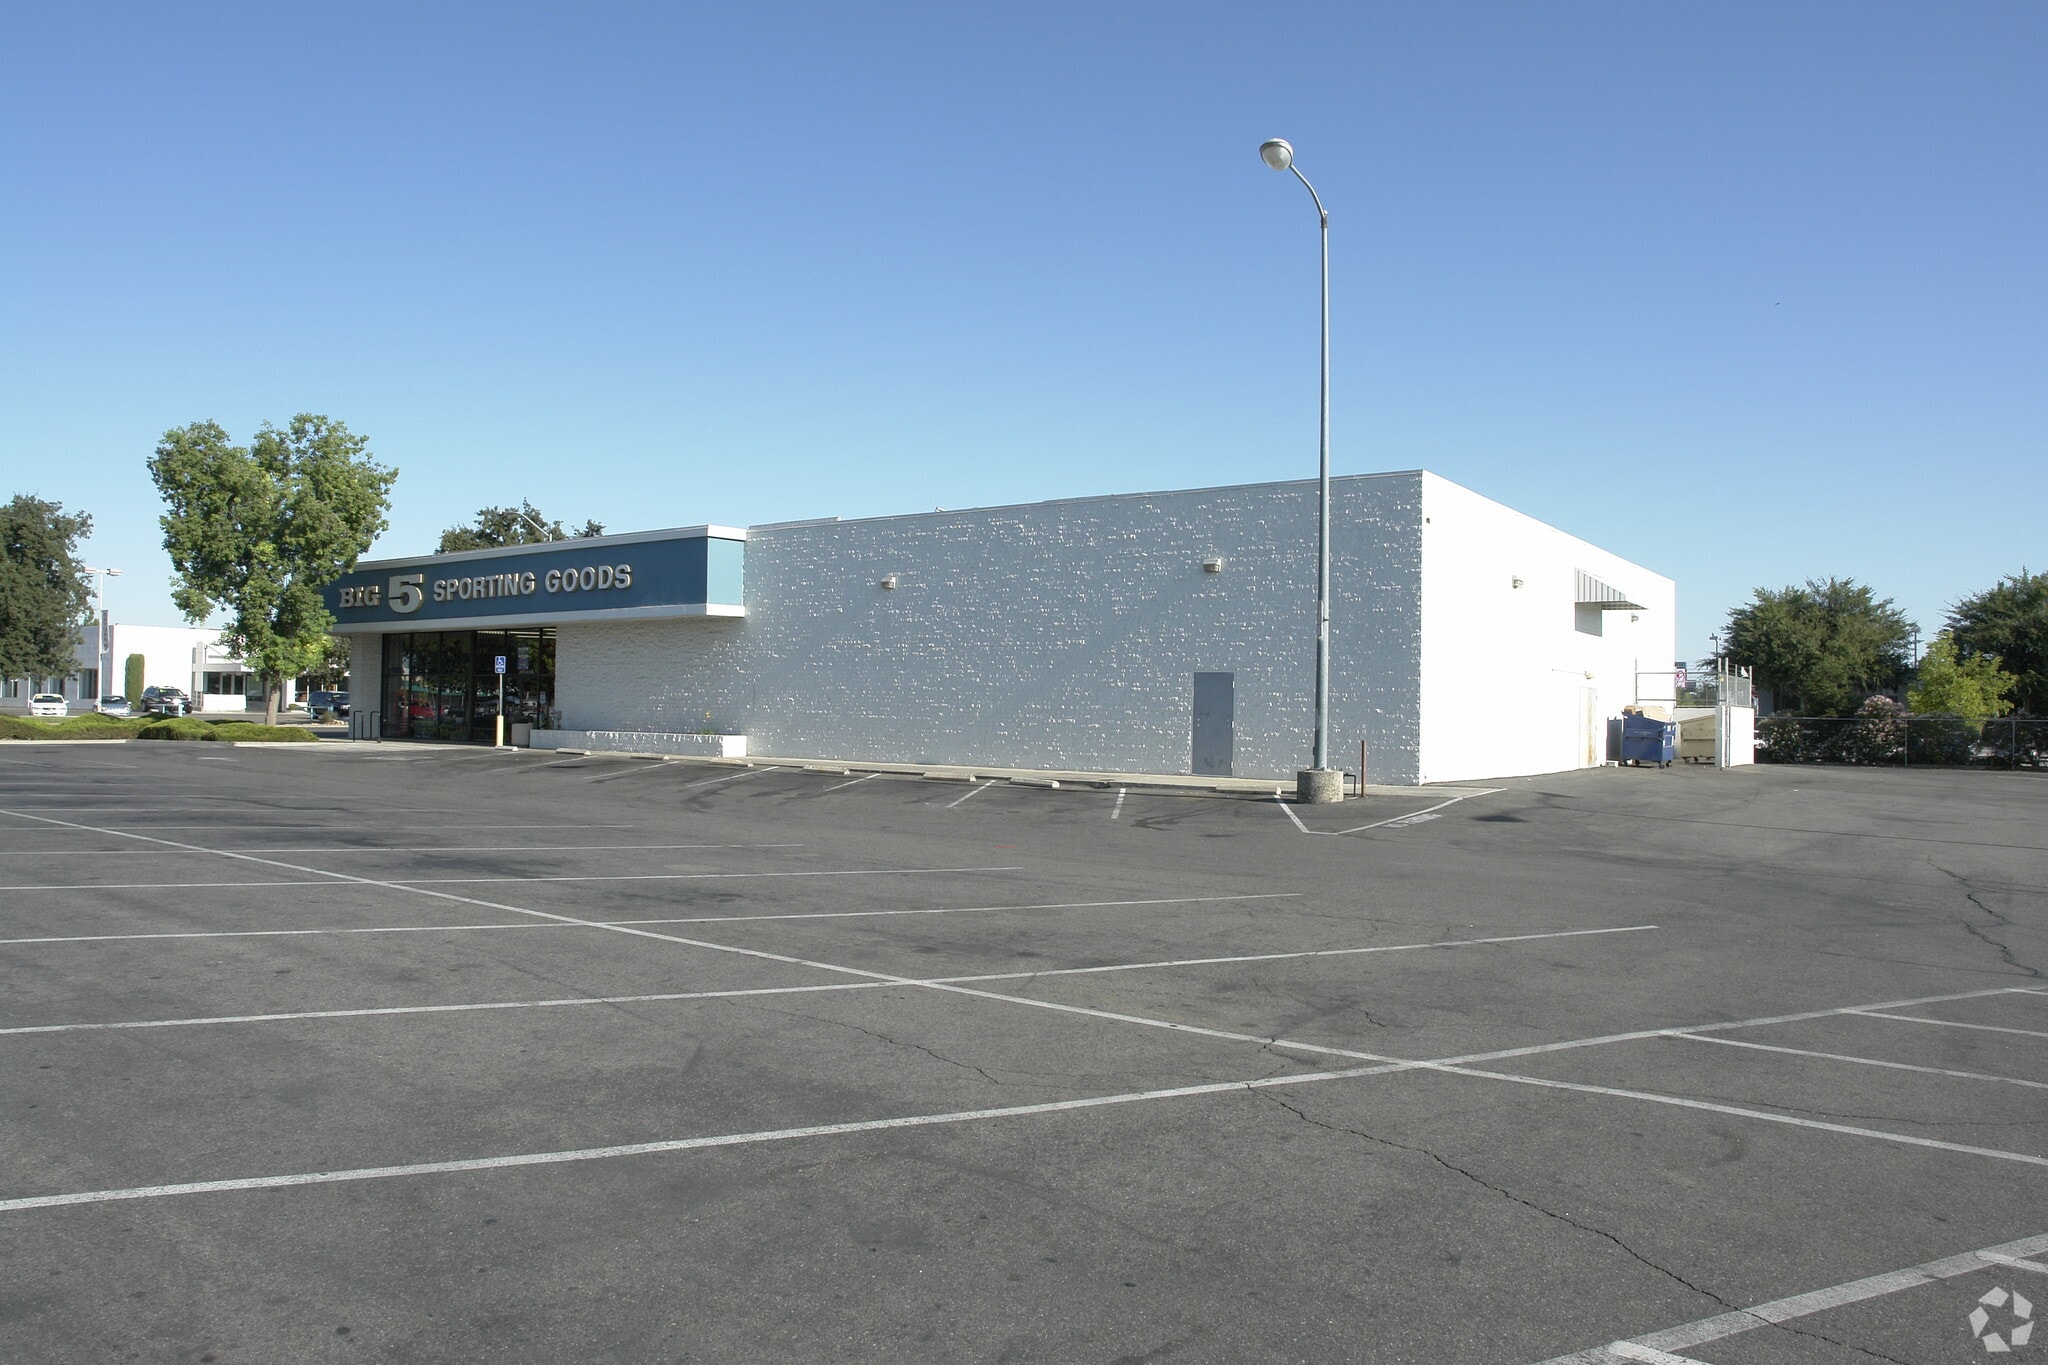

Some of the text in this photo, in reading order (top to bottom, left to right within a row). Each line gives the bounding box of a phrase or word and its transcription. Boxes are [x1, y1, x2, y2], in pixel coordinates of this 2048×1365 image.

[339, 564, 632, 613] BIG 5 SPORTING GOODS
